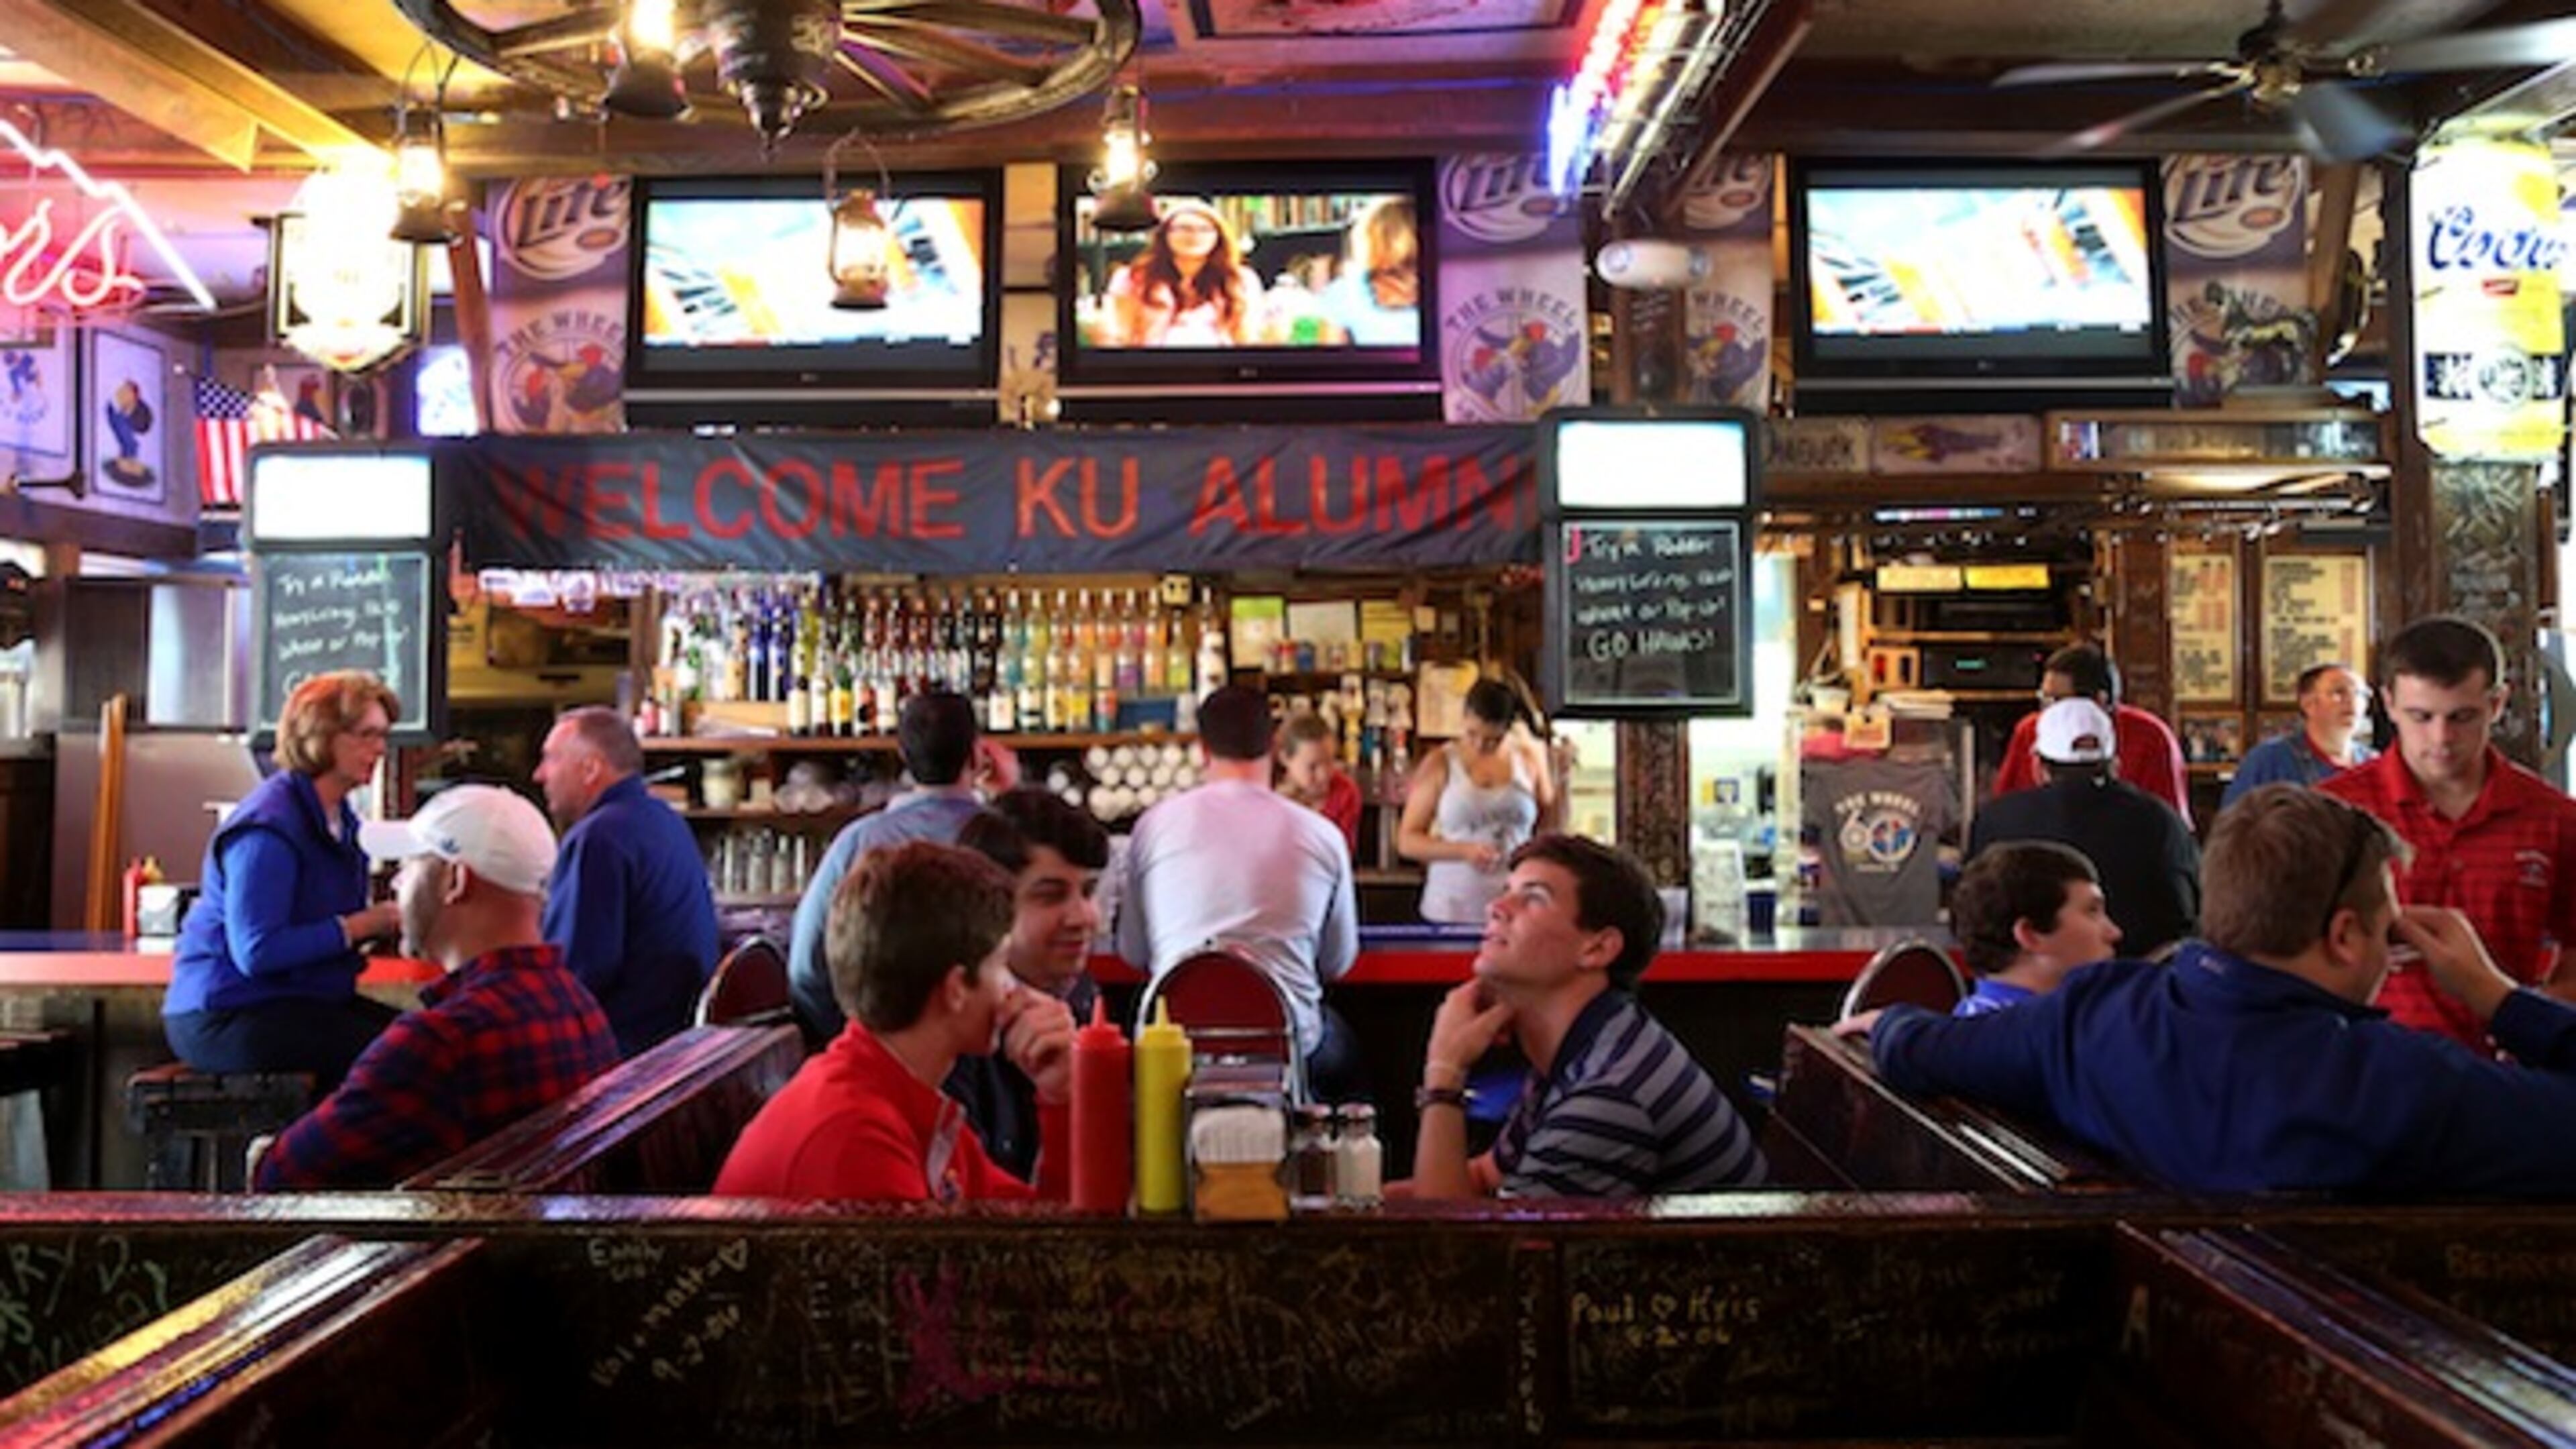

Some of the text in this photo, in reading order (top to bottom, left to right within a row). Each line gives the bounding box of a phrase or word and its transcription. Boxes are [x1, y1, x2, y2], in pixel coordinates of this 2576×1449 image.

[2174, 157, 2289, 223] Lite
[515, 176, 629, 249] Lite
[1445, 288, 1576, 331] THE WHEEL
[552, 311, 628, 352] WHEE
[491, 458, 964, 539] WELCOME
[1016, 457, 1139, 537] KU
[1587, 629, 1630, 662] GO
[1570, 1284, 1763, 1325] Paul Kris
